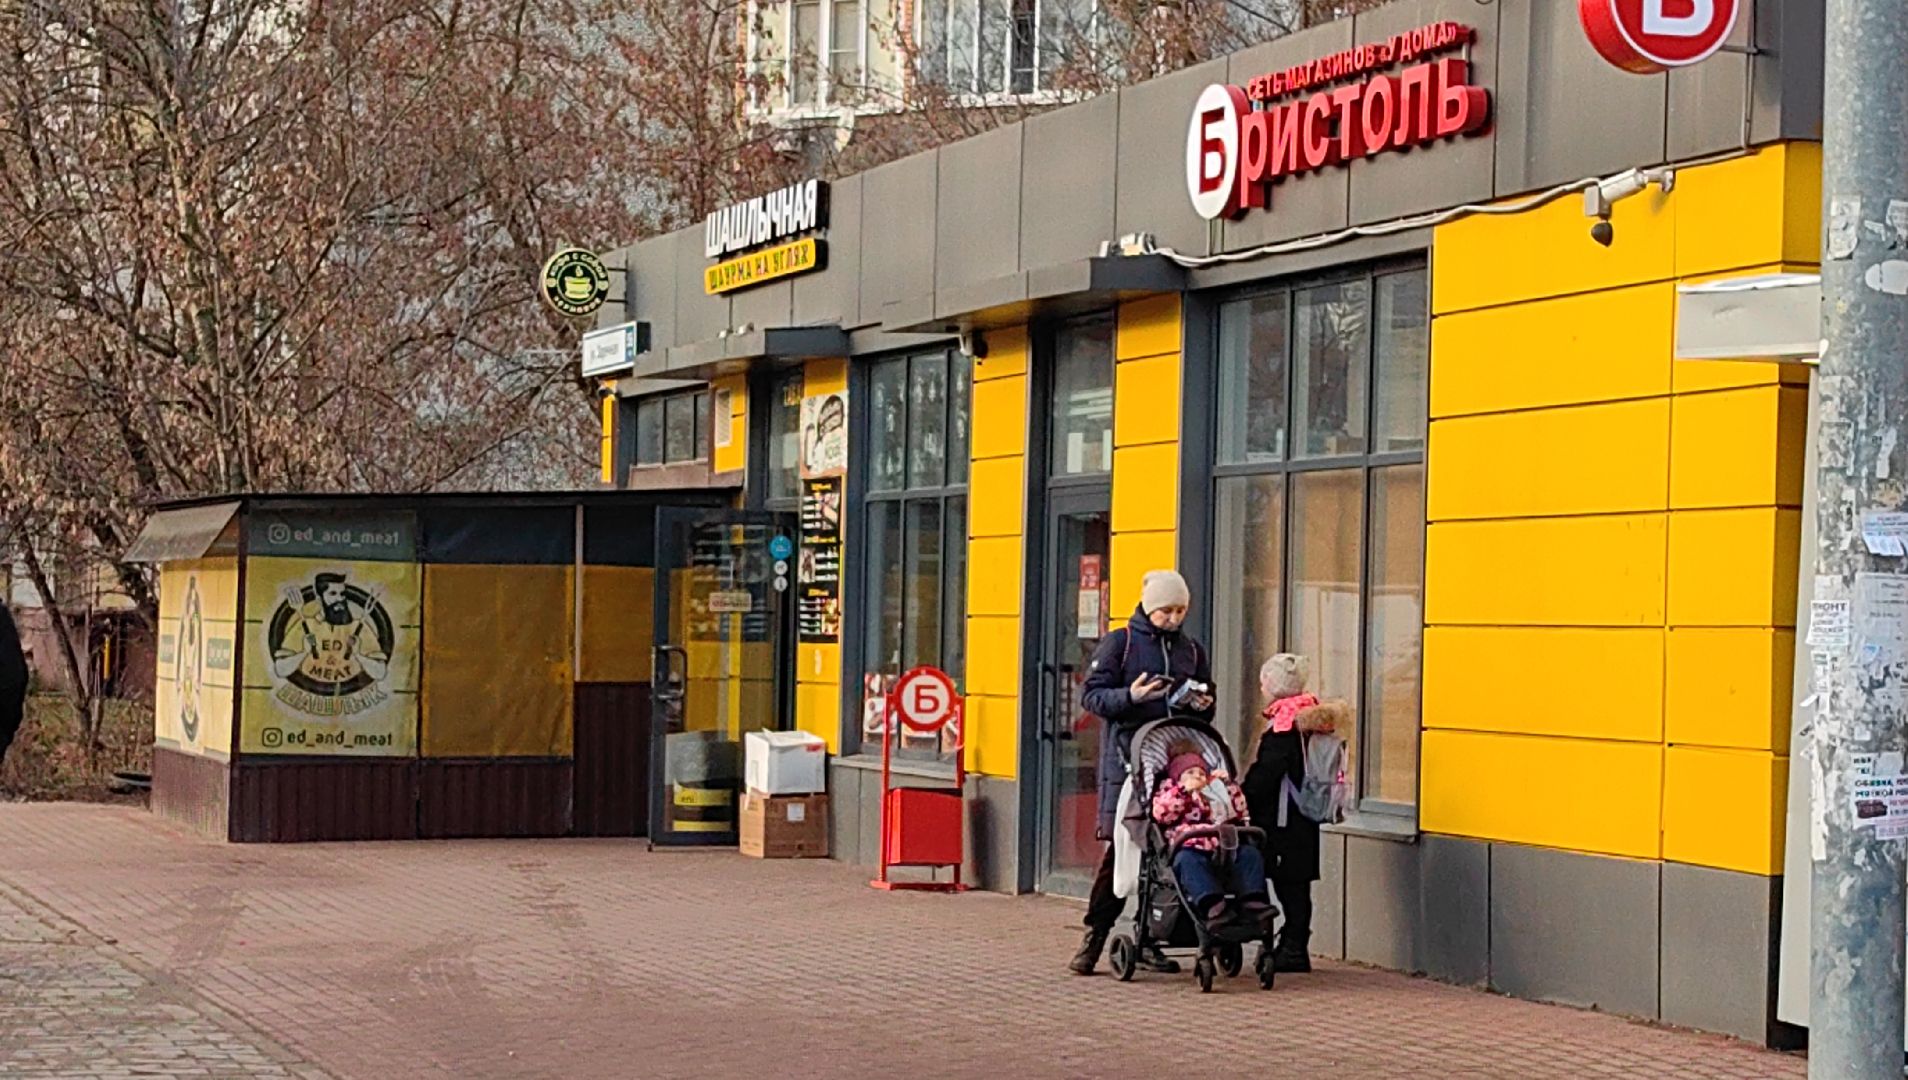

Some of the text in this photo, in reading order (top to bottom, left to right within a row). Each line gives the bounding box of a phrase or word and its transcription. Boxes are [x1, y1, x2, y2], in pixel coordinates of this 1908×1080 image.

[1248, 72, 1282, 99] СЕТЬ
[1285, 46, 1375, 89] МАГАЗИНОВ
[1400, 21, 1457, 62] ДОМА»
[705, 178, 818, 259] ШАШЛЫЧНАЯ
[708, 243, 809, 291] ШАУРМА НА УГЛЯХ
[294, 527, 399, 547] ed_and_meat
[321, 640, 343, 651] ED
[309, 664, 352, 681] MEAT
[914, 684, 940, 714] Б
[287, 728, 392, 748] ed_and_meat
